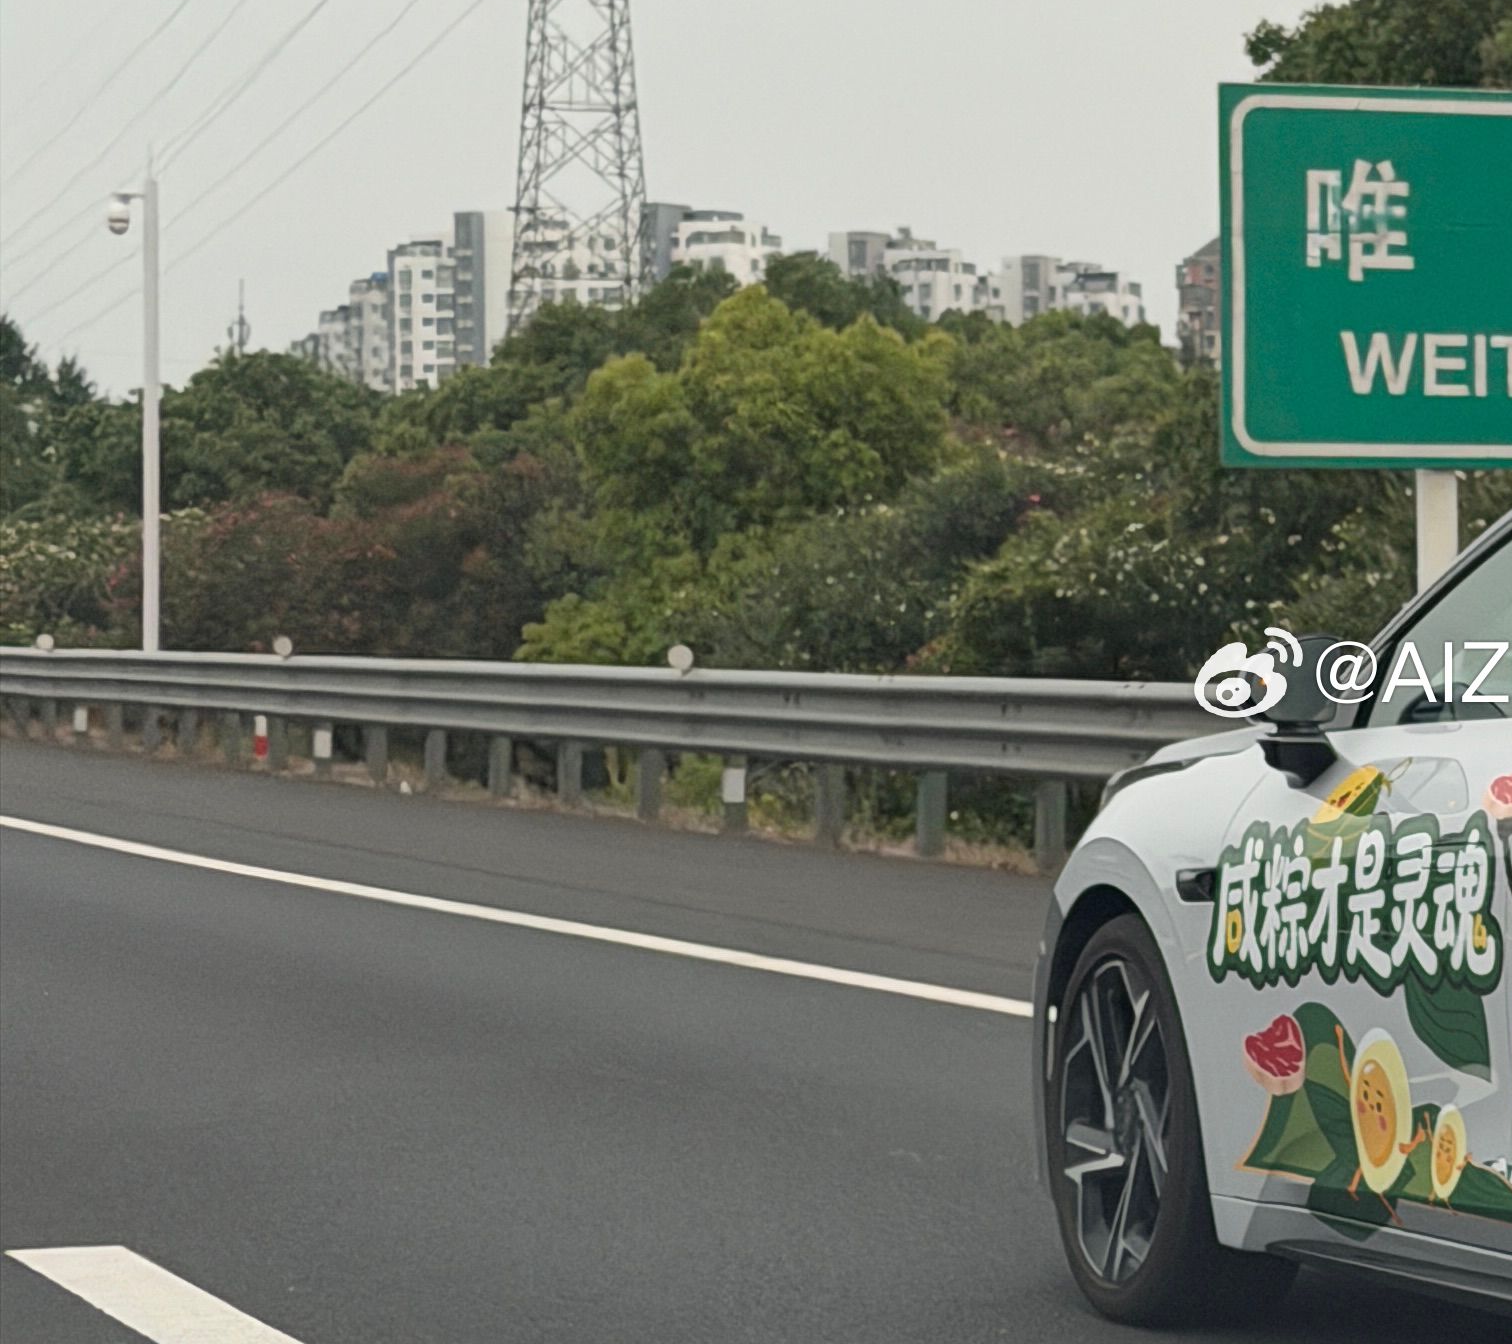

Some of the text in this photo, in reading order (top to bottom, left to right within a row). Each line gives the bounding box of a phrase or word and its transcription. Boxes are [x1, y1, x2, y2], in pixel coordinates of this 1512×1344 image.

[1212, 828, 1497, 979] 咸粽才是灵魂
